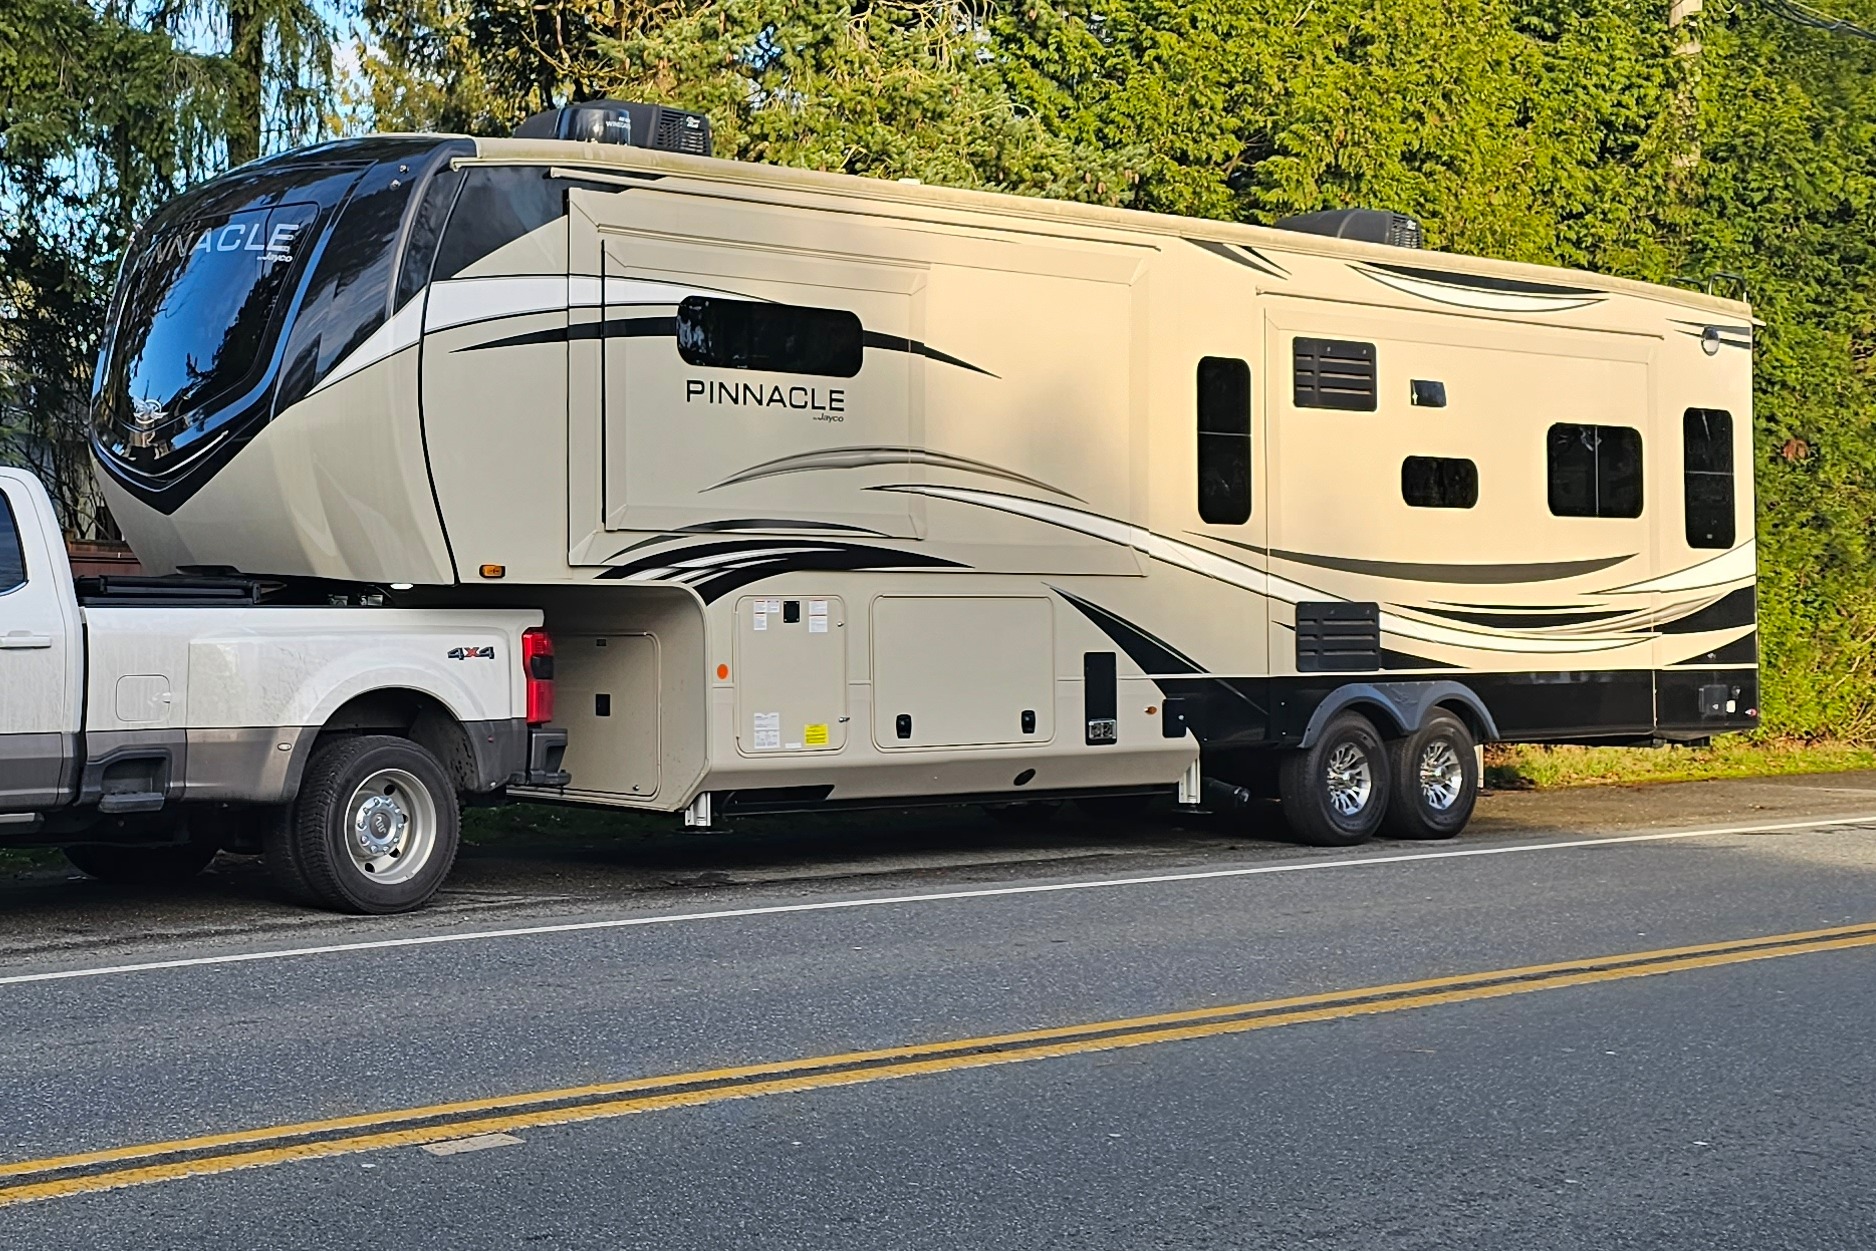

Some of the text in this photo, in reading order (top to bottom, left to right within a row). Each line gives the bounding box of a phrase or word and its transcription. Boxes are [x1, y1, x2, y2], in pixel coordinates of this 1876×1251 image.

[137, 223, 299, 268] NNACLE
[686, 379, 845, 412] PINNACLE
[818, 412, 844, 423] Jayco
